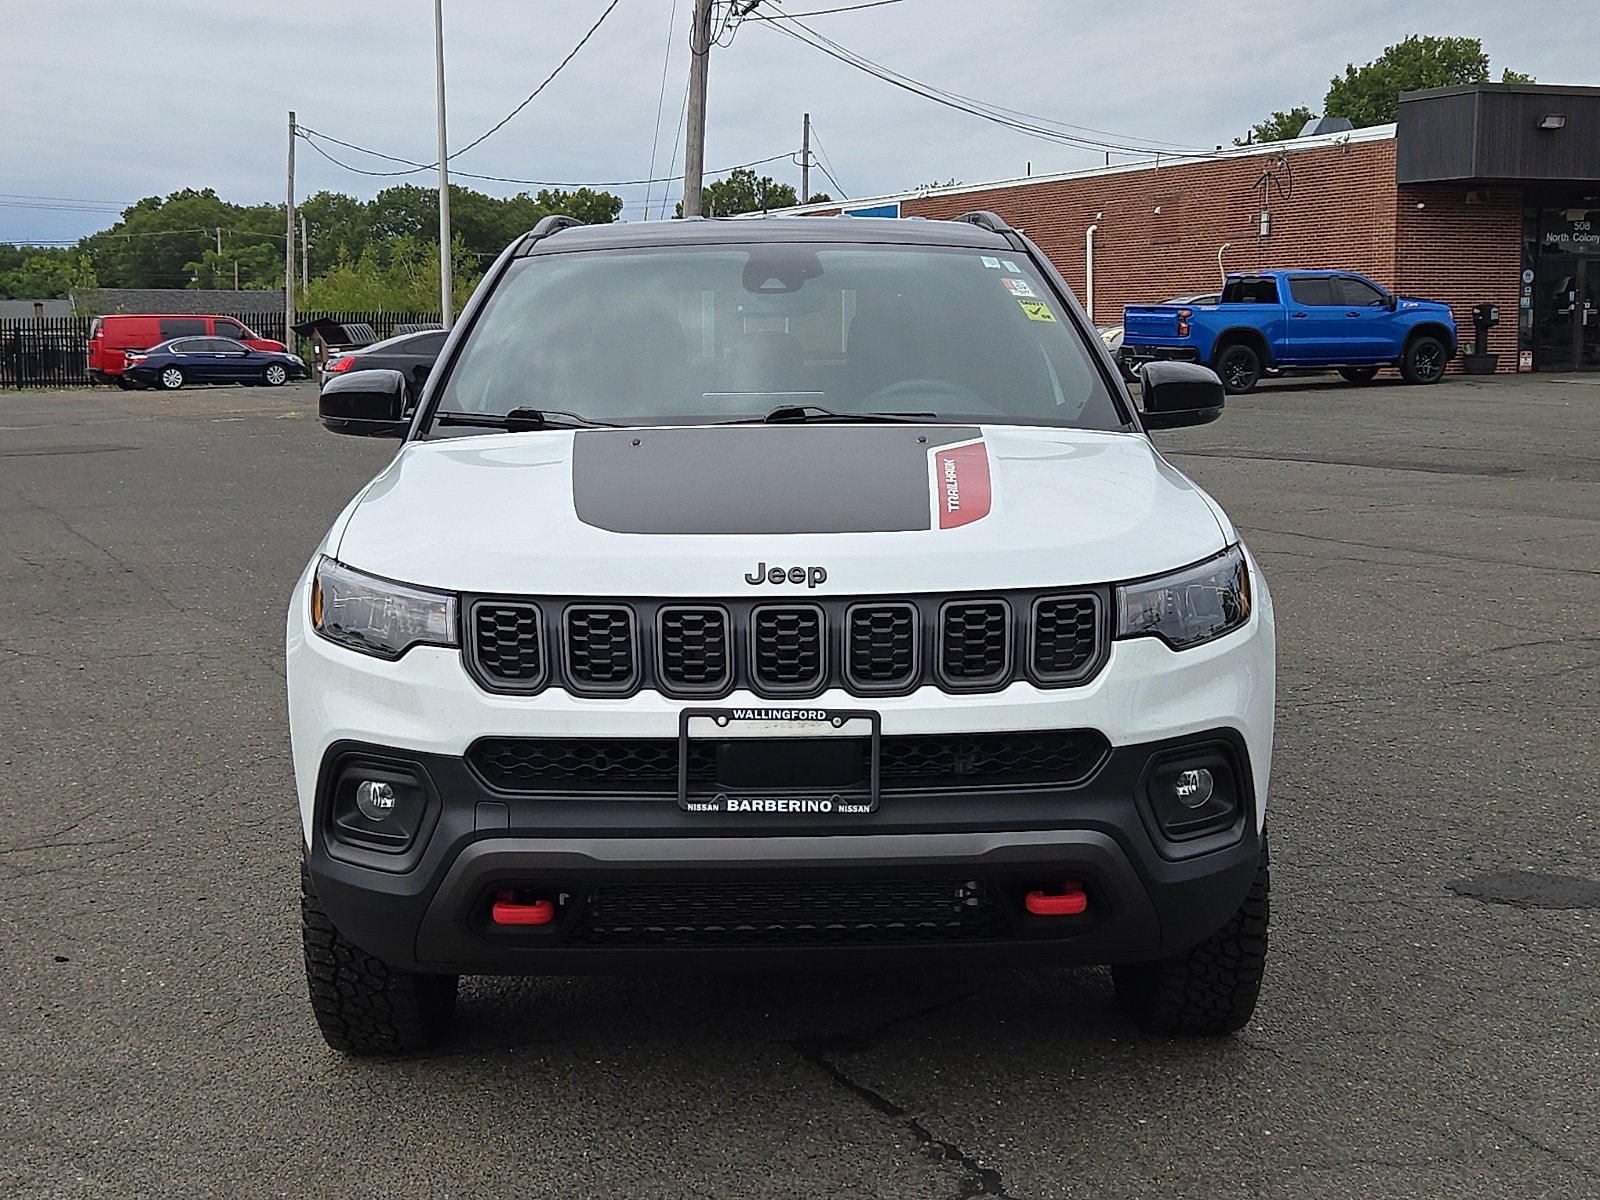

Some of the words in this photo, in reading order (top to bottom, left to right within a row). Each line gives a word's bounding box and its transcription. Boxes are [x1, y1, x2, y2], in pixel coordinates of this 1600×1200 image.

[1573, 221, 1591, 231] 508
[1546, 232, 1570, 242] North
[1572, 232, 1600, 244] Colony
[943, 458, 960, 513] TRAILHAWK
[745, 562, 828, 588] Jeep
[733, 709, 827, 720] WALLINGFORD
[727, 800, 832, 812] BARBERINO
[838, 805, 870, 813] NISSAN
